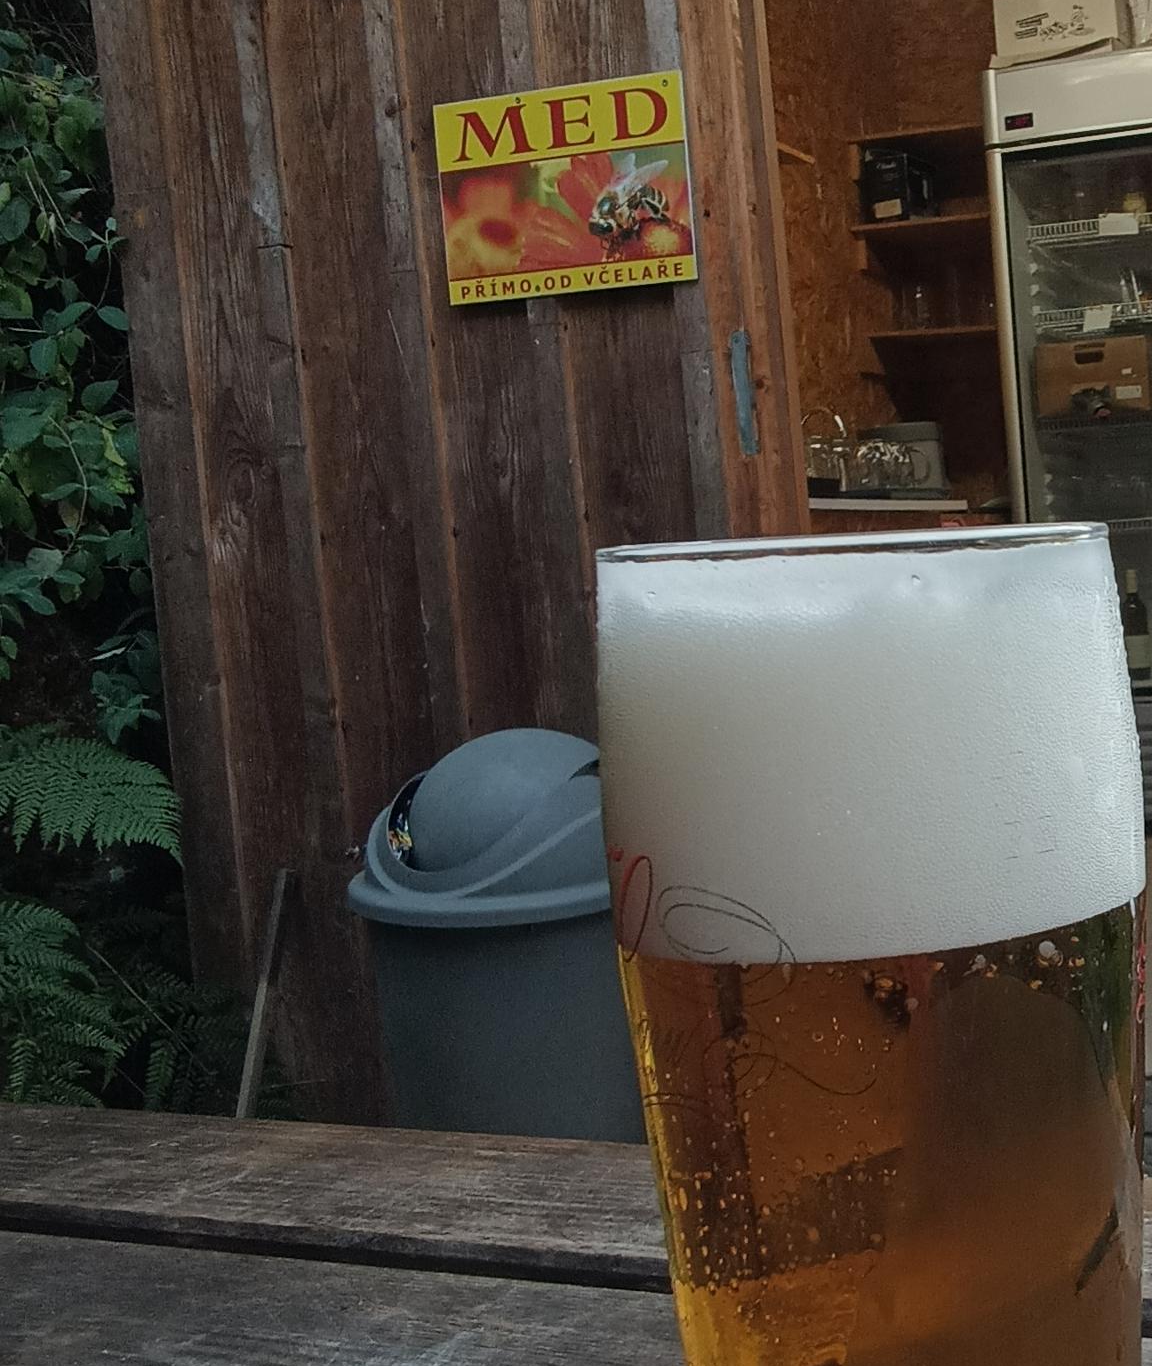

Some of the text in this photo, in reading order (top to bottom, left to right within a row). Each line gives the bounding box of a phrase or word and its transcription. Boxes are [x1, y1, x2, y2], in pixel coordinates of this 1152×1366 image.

[452, 87, 668, 163] MED
[460, 259, 684, 300] PŘÍMO OD VČELAŘE
